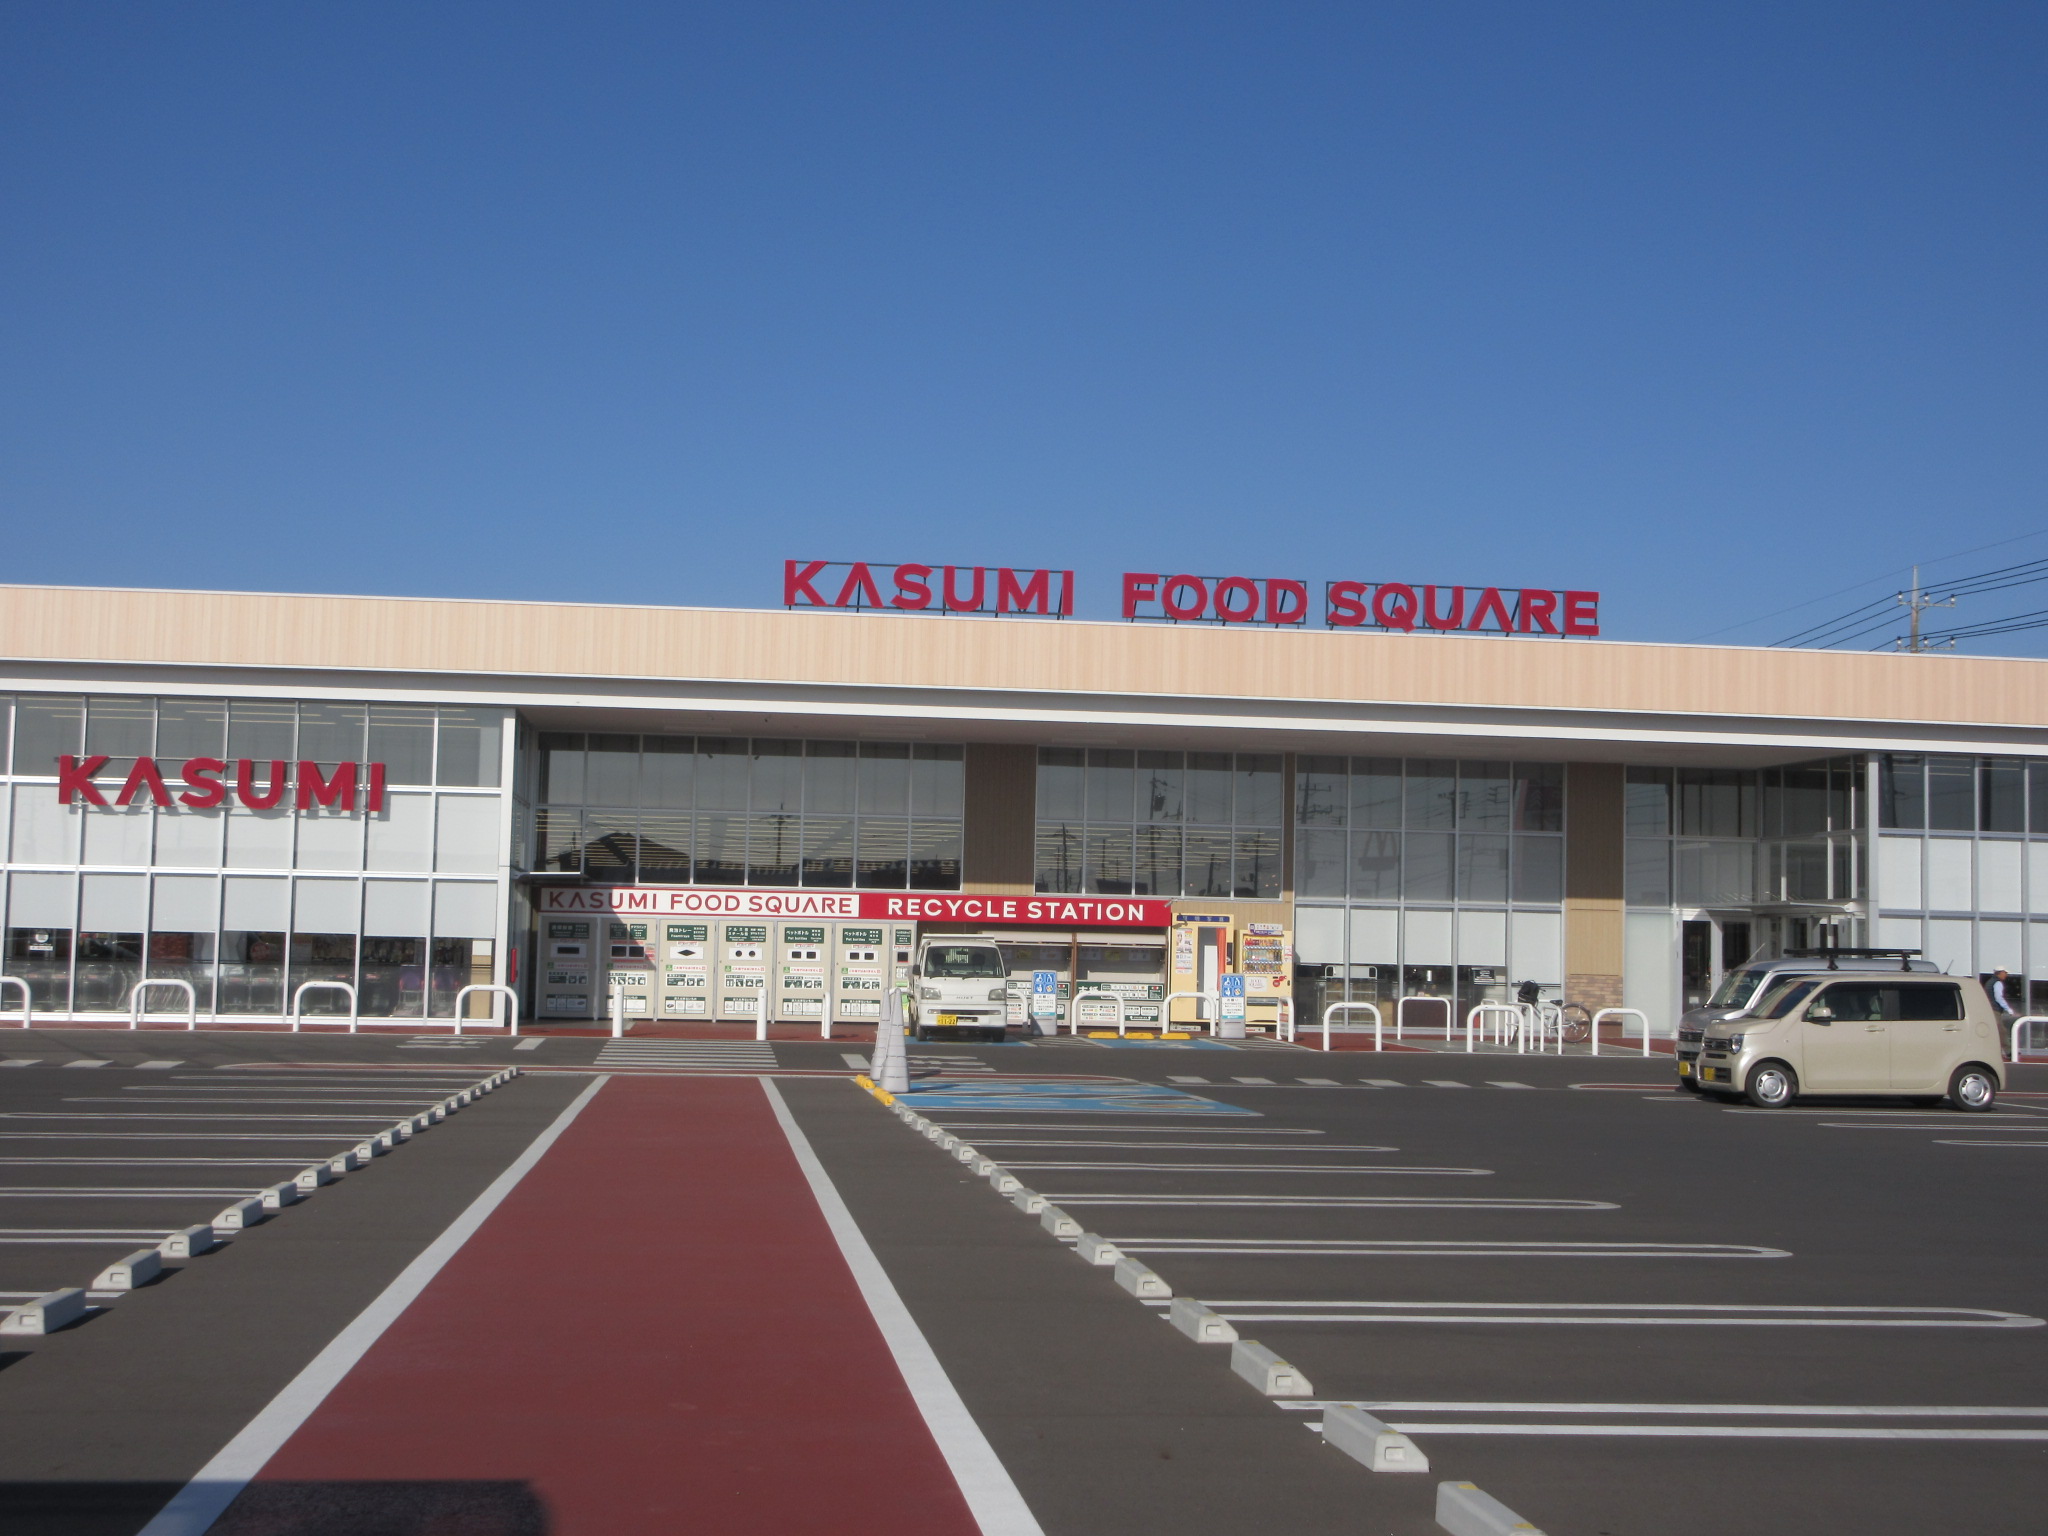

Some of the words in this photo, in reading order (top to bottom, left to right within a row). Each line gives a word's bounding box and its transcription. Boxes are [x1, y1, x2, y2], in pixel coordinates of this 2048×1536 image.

[785, 560, 1074, 616] KASUMI
[1124, 573, 1309, 624] FOOD
[1328, 580, 1600, 636] SQUARE
[59, 754, 386, 814] KASUMI
[550, 891, 657, 909] KASUMI
[670, 894, 741, 911] FOOD
[748, 896, 854, 914] SQUARE
[888, 899, 1017, 919] RECYCLE
[1027, 901, 1145, 921] STATION
